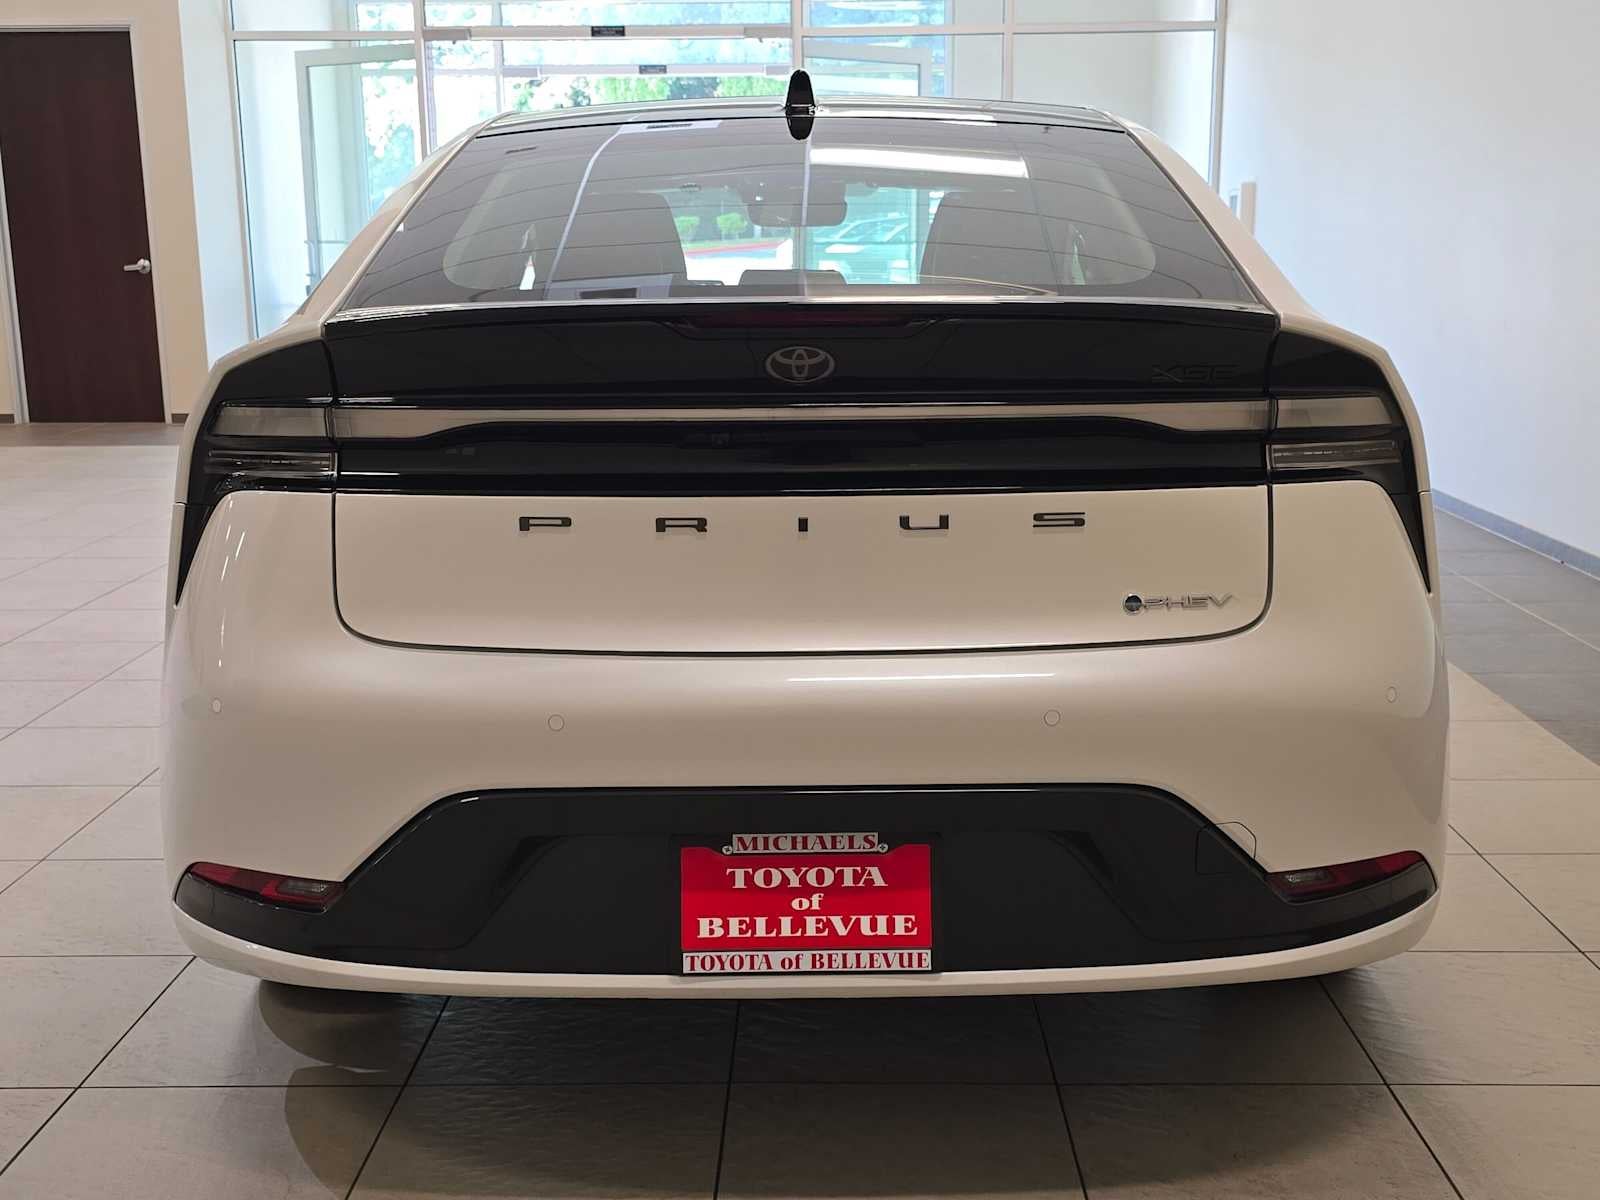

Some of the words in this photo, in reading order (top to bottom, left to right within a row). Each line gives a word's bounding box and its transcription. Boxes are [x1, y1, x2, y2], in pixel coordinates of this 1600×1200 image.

[519, 512, 1085, 533] PRIUS
[1143, 594, 1233, 613] PHEV
[735, 834, 876, 851] MICHAELS
[726, 866, 888, 889] TOYOTA
[791, 893, 823, 911] of
[697, 915, 918, 938] BELLEVUE
[685, 954, 773, 971] TOYOTA
[780, 953, 803, 970] of
[811, 952, 929, 969] BELLEVUE
